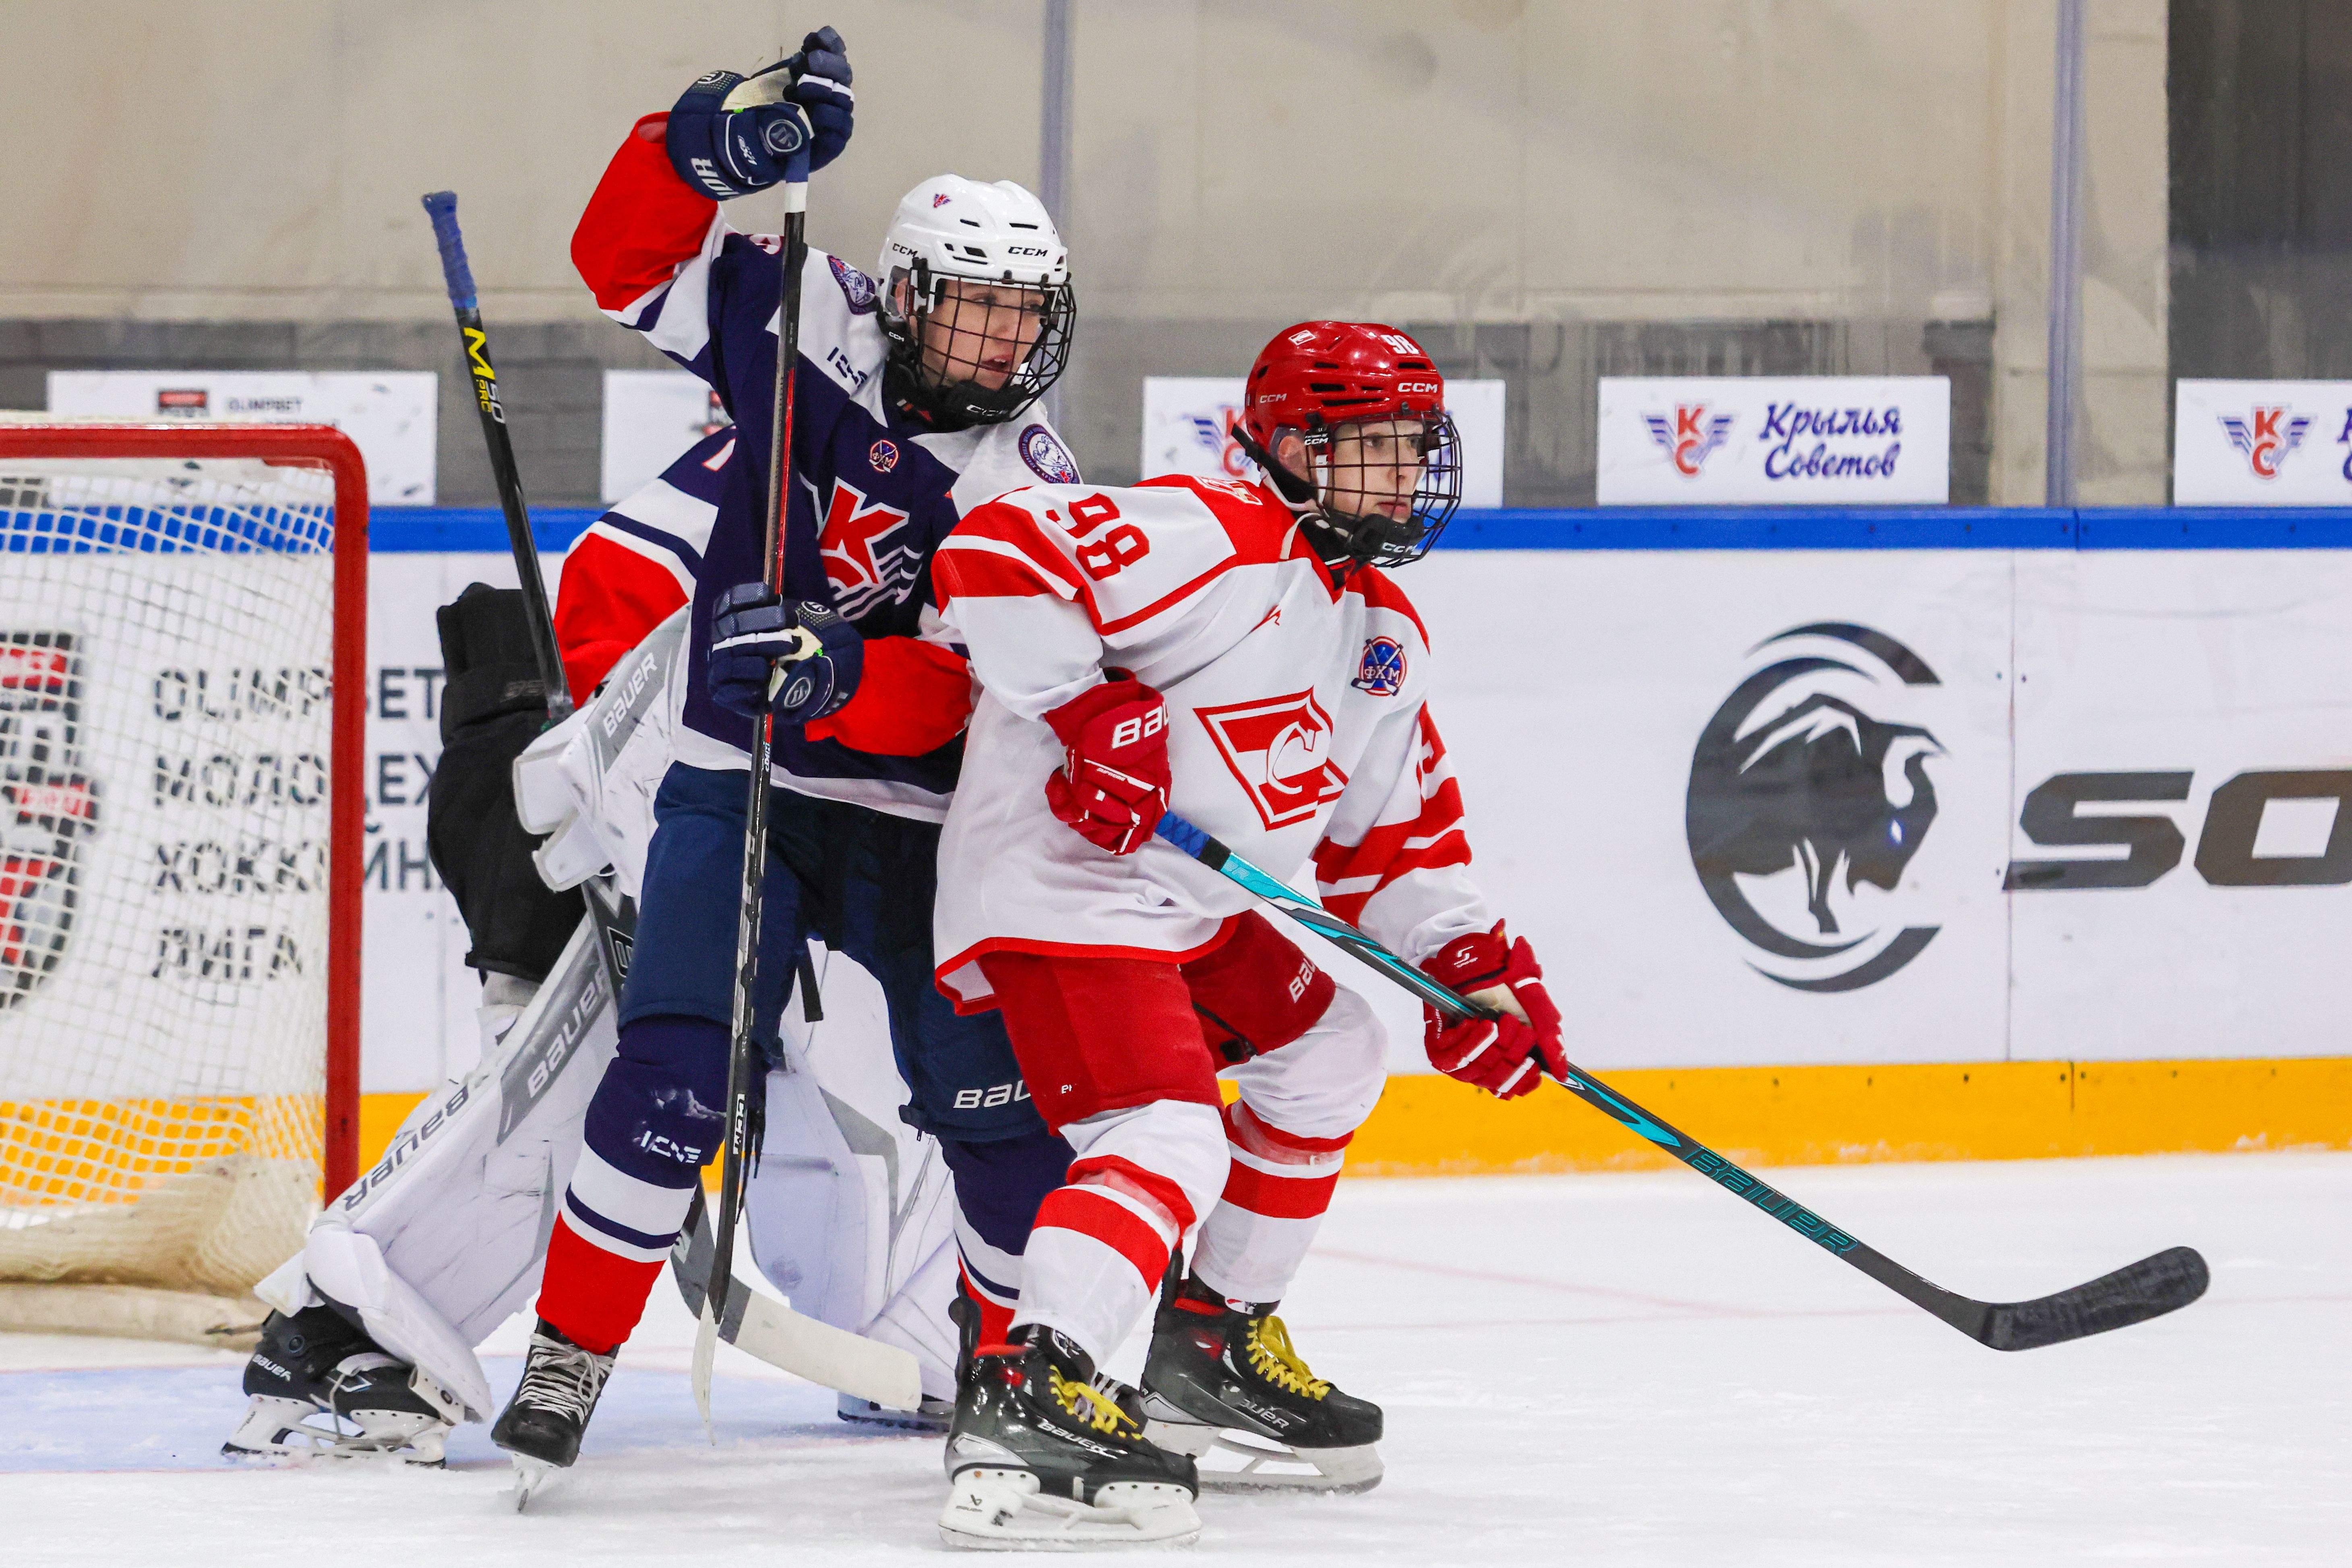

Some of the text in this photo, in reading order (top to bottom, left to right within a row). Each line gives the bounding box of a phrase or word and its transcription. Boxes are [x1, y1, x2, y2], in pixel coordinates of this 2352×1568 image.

[893, 243, 918, 257] CCM
[1008, 246, 1048, 257] CCM
[1380, 335, 1420, 354] 98
[1260, 393, 1287, 403] CCM
[1398, 383, 1438, 393] CCM
[1759, 403, 1901, 450] Крылья
[1765, 443, 1901, 479] Советов
[1046, 492, 1150, 581] 98
[154, 668, 444, 720] OLIMPET
[604, 652, 657, 738] BAUER
[1364, 665, 1400, 684] ФХМ
[2002, 769, 2352, 889] SO
[152, 926, 302, 978] ЛИГА
[733, 1094, 745, 1155] CCM
[344, 1084, 469, 1212] BAUER
[252, 1353, 292, 1382] BAUER
